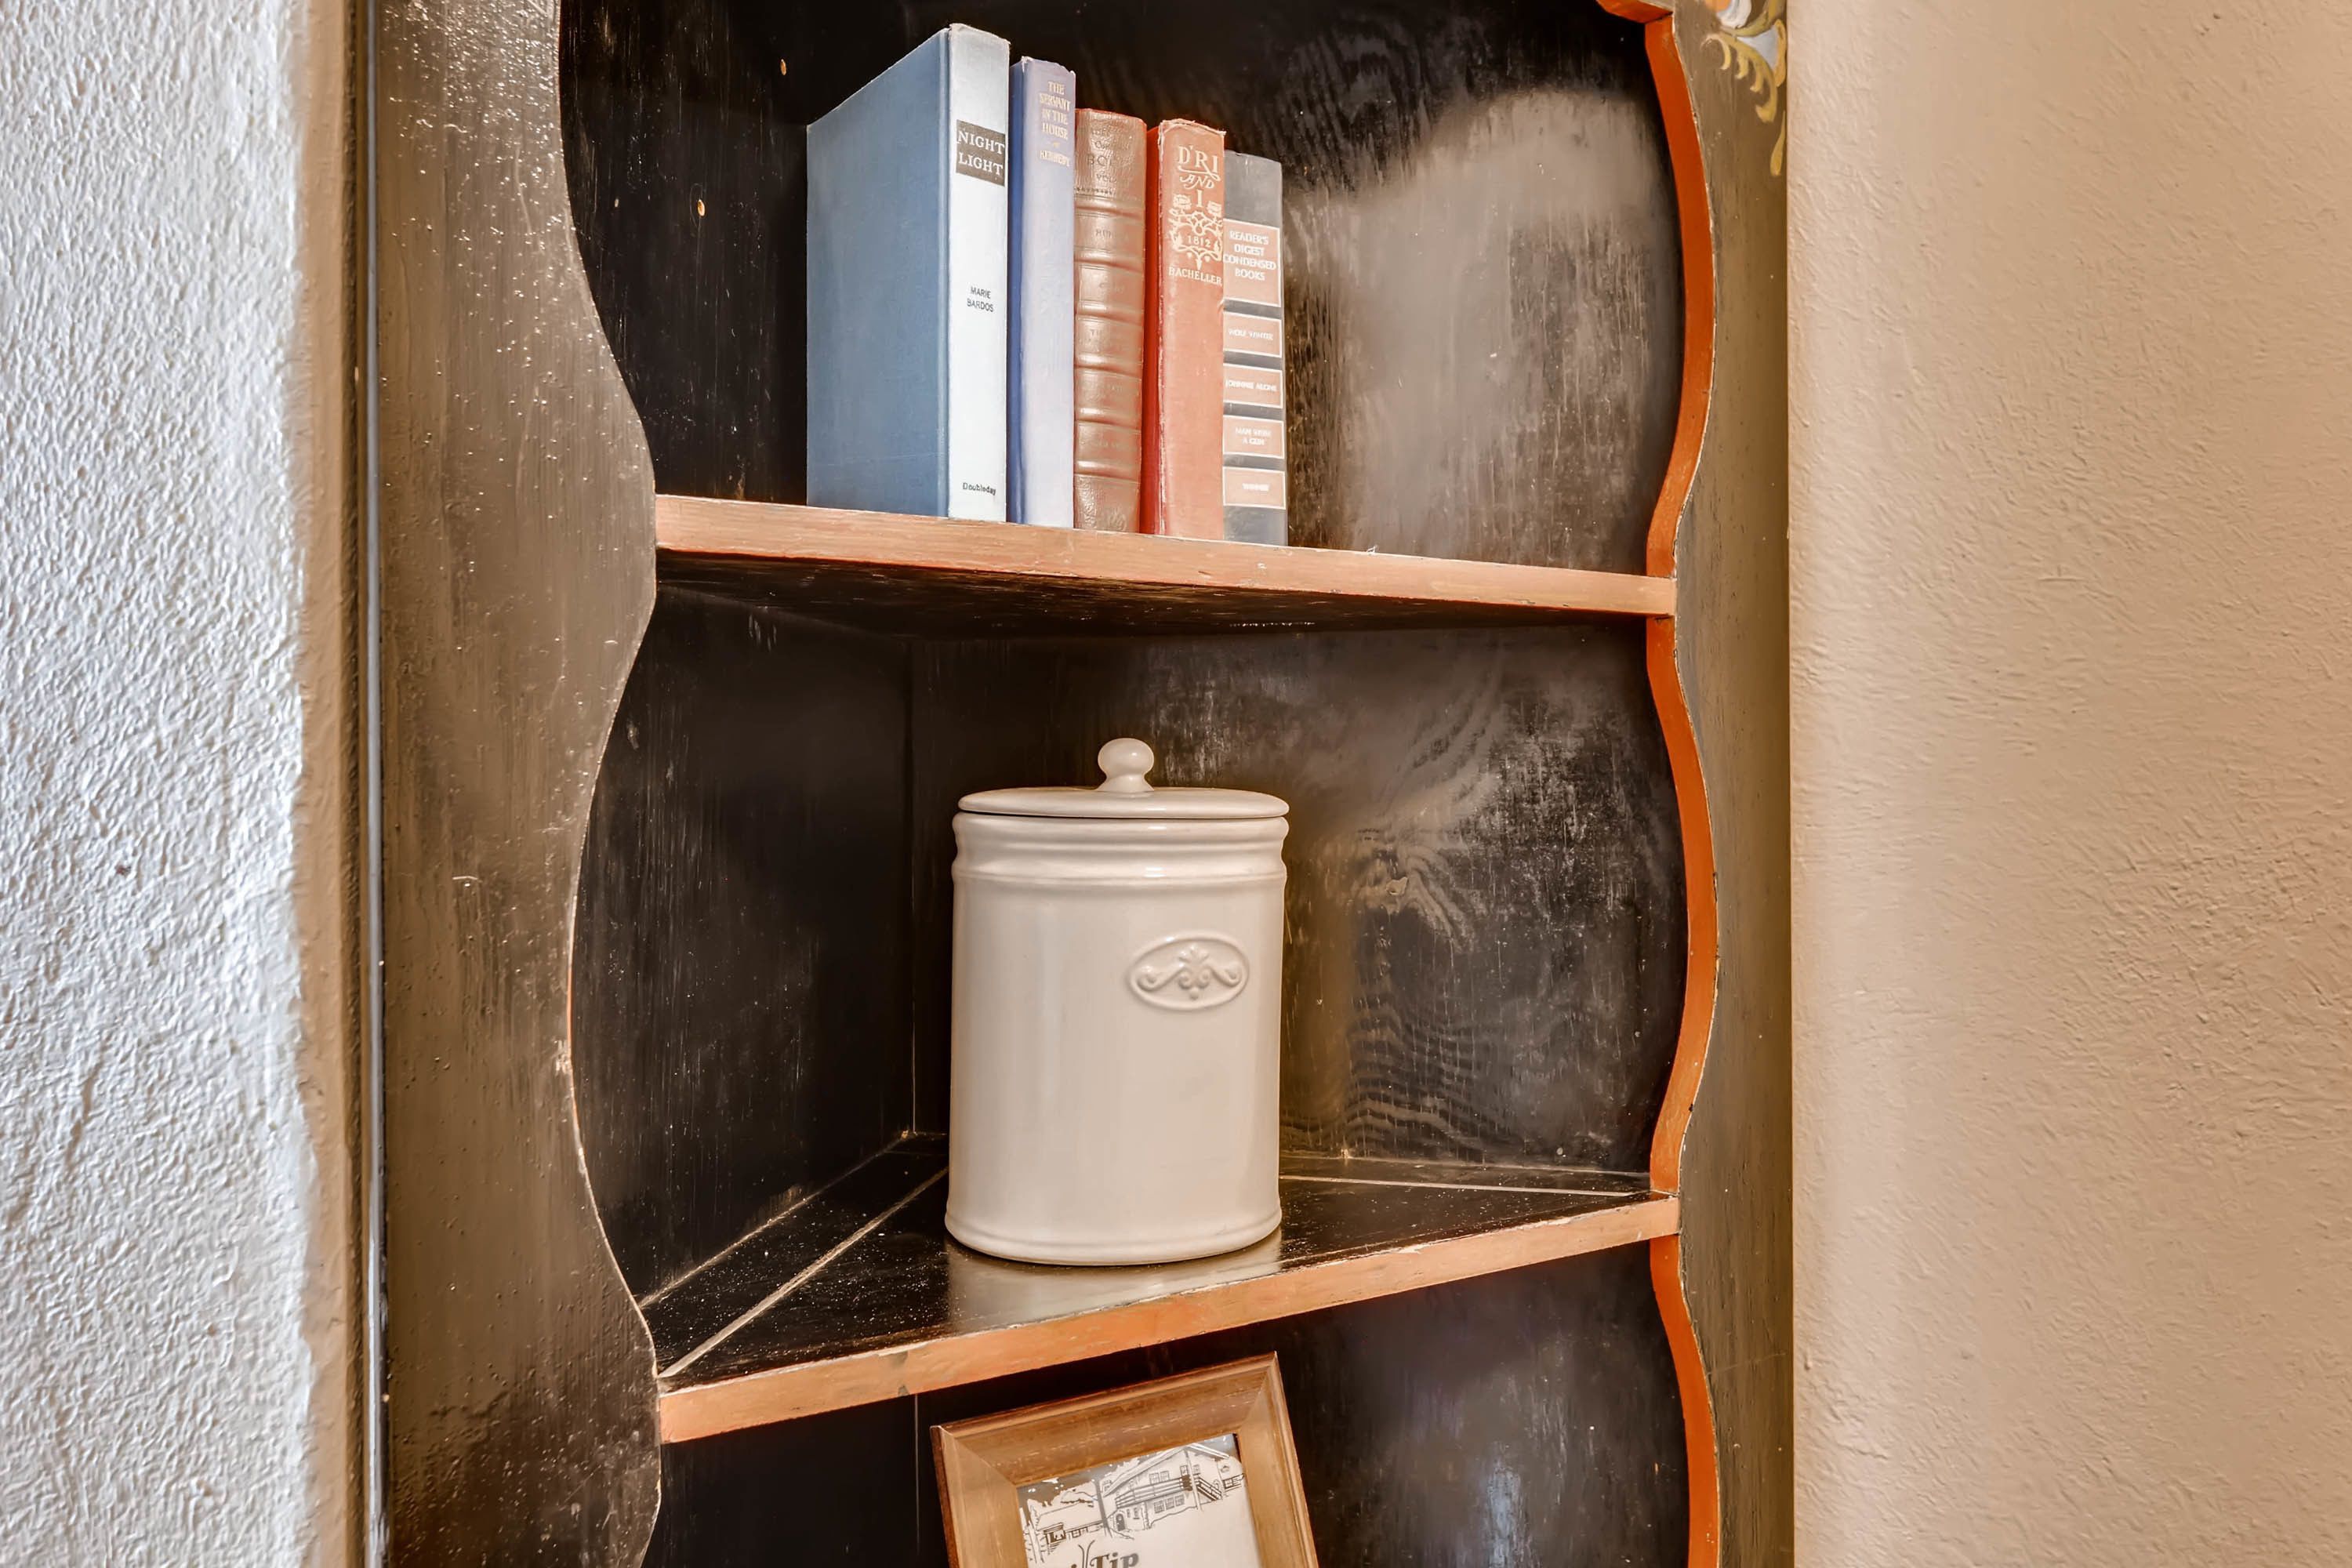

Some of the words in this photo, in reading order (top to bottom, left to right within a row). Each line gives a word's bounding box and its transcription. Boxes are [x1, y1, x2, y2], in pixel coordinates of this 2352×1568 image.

[1048, 81, 1065, 95] THE
[1040, 93, 1071, 111] SERVANT
[1052, 110, 1069, 125] THE
[1042, 122, 1069, 140] HOUSE
[956, 130, 1005, 154] NIGHT
[958, 152, 1004, 176] LIGHT
[1179, 173, 1215, 190] AND
[1196, 189, 1203, 208] I
[1188, 235, 1211, 248] 1812
[1229, 230, 1269, 245] READER'S
[1234, 243, 1265, 257] DIGEST
[1223, 253, 1276, 270] CONDENSED
[1169, 265, 1223, 287] BACHELLER
[1235, 267, 1265, 281] BOOKS
[971, 285, 992, 299] MARIE
[967, 297, 994, 313] BARDOS
[962, 482, 996, 496] Doubleday
